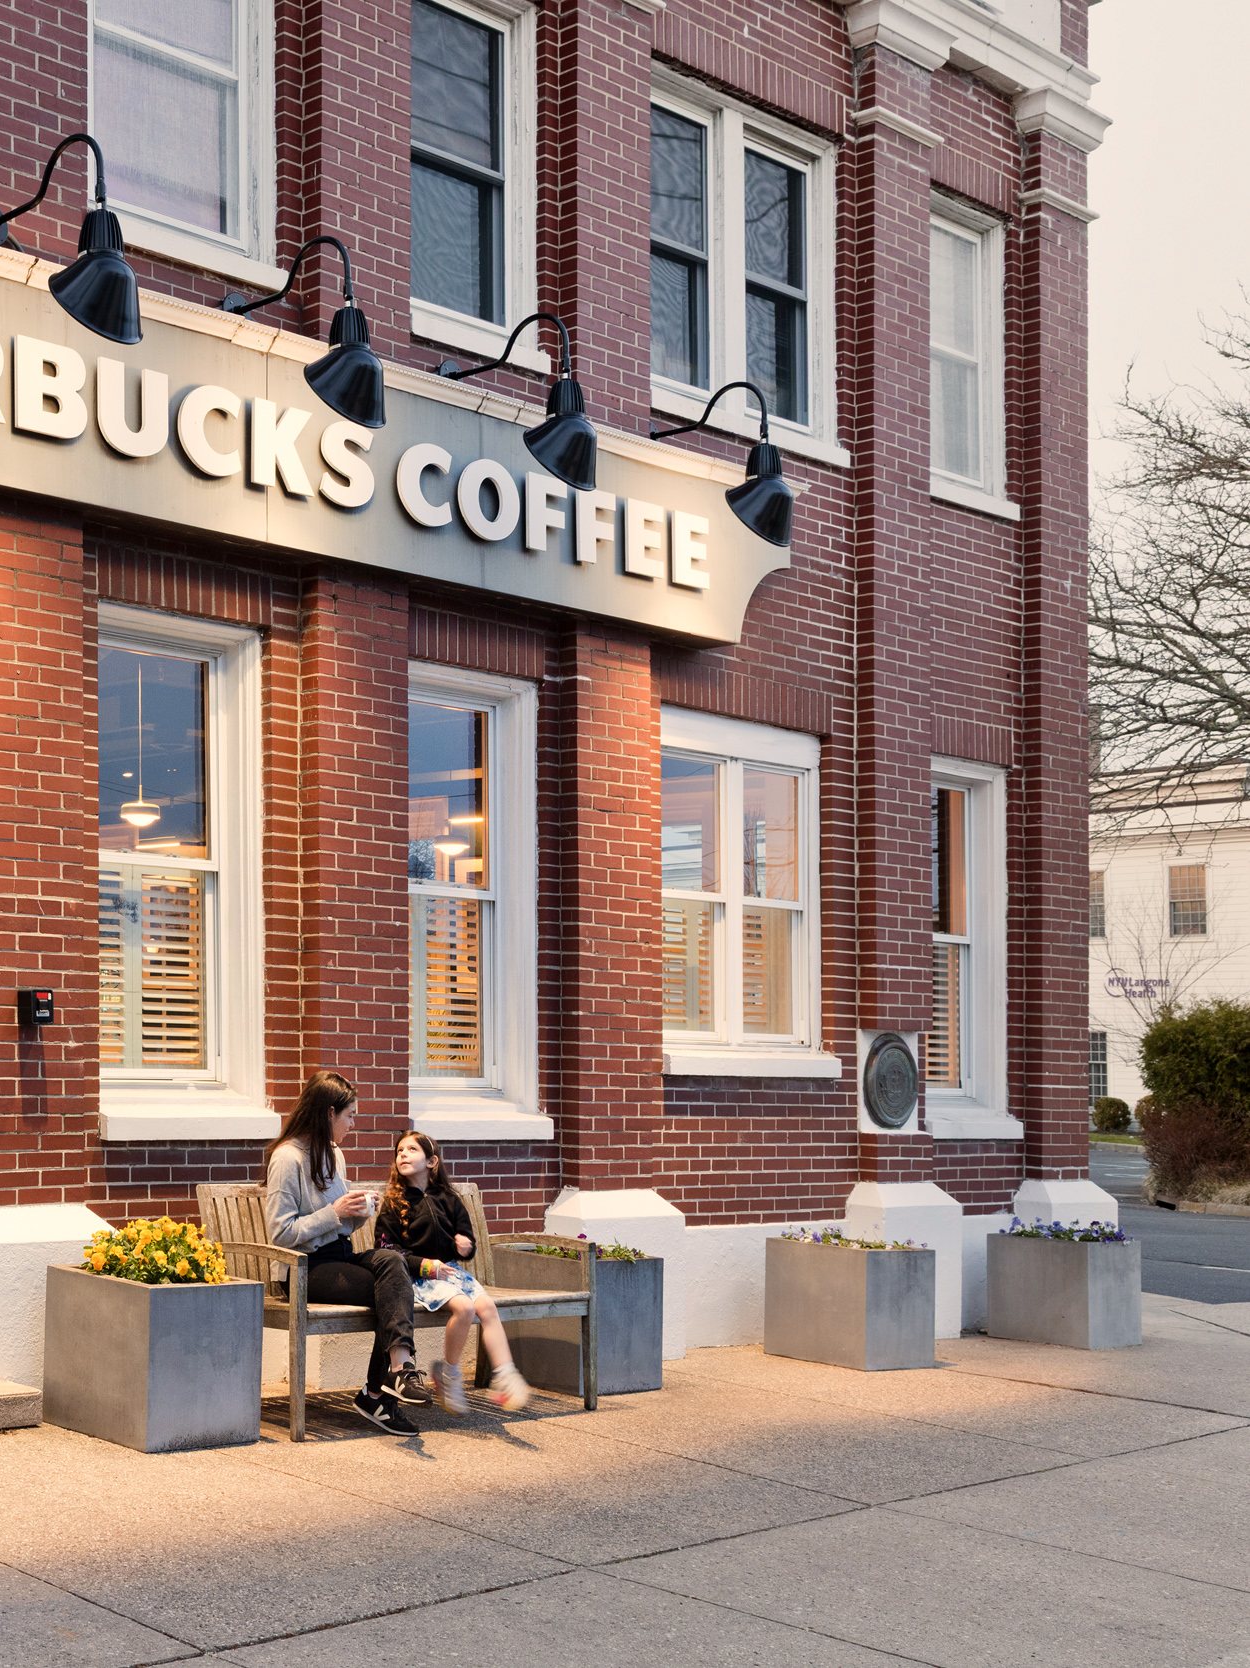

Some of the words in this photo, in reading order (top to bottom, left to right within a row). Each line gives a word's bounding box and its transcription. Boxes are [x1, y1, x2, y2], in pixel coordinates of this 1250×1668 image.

[396, 442, 710, 590] COFFEE
[1108, 977, 1128, 987] NYU
[1128, 977, 1170, 988] Langone
[1125, 988, 1157, 998] Health
